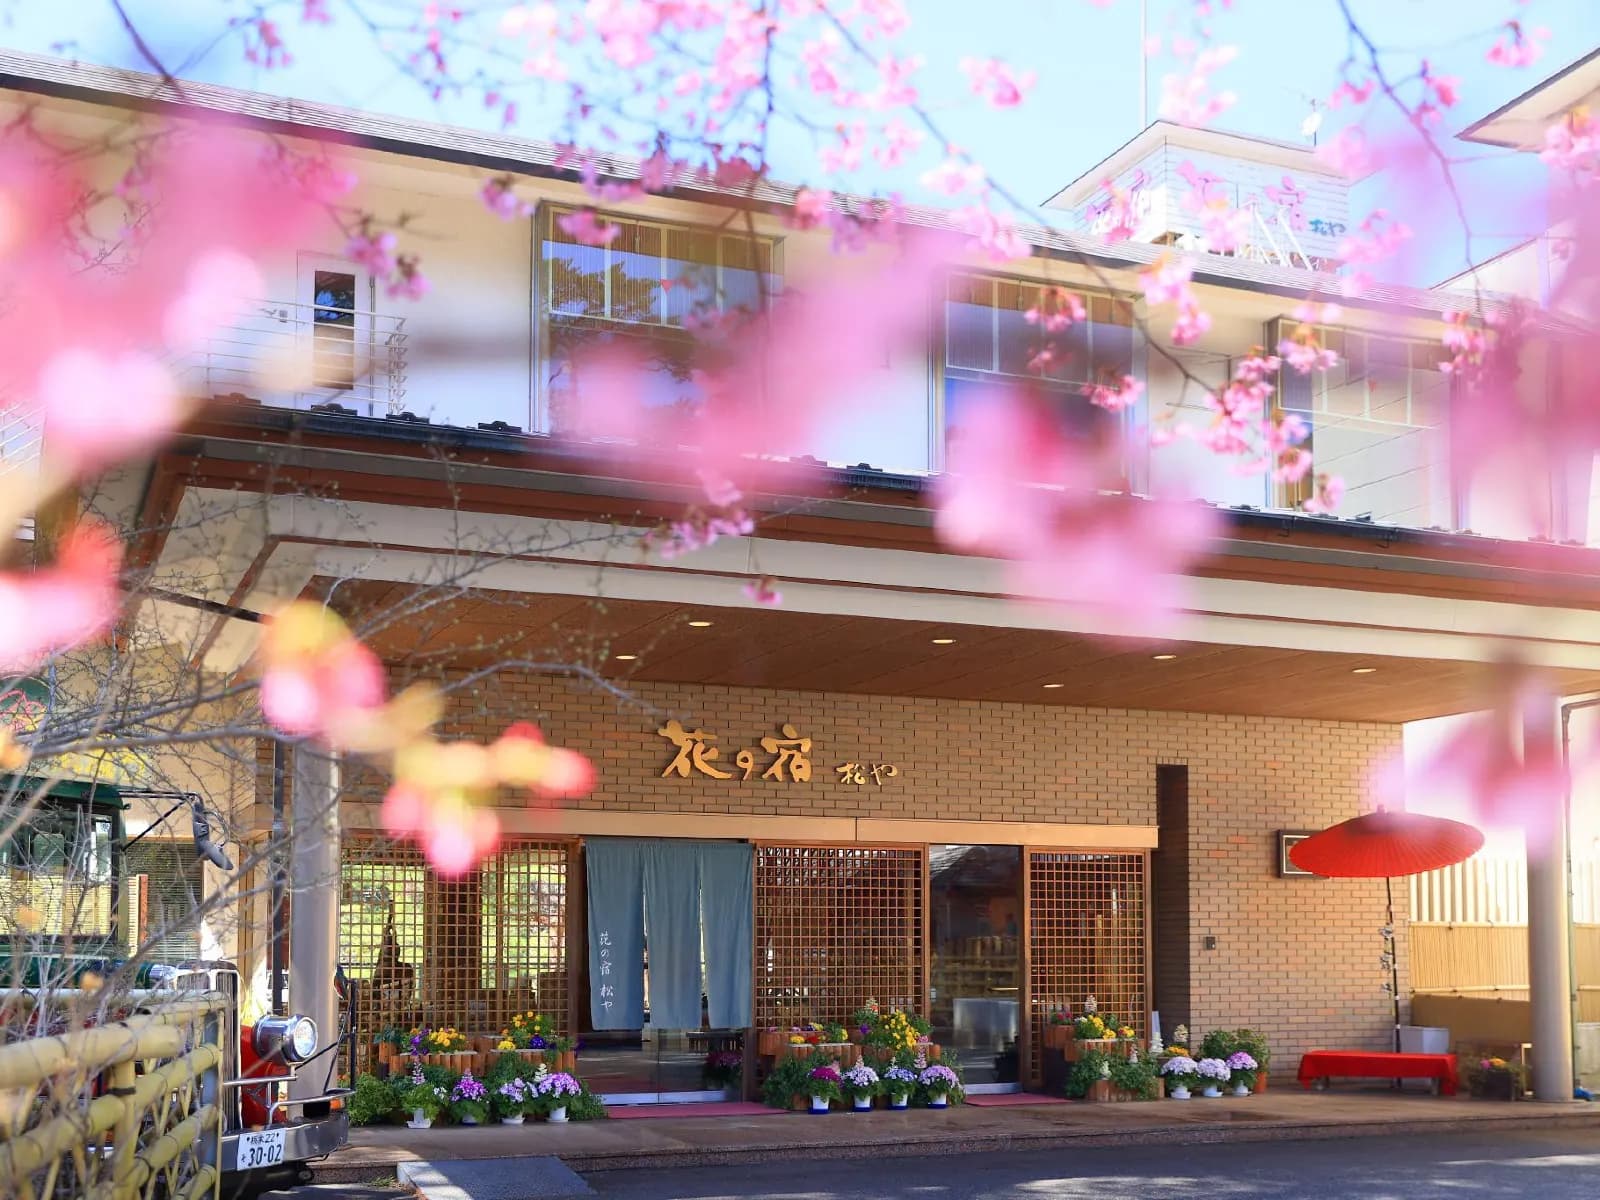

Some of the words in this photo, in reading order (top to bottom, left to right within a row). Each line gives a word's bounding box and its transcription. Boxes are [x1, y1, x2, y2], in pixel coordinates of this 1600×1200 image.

[658, 719, 811, 783] 花の宿
[836, 762, 897, 786] 松や
[600, 929, 612, 976] 花の宿
[600, 984, 614, 1012] 松や
